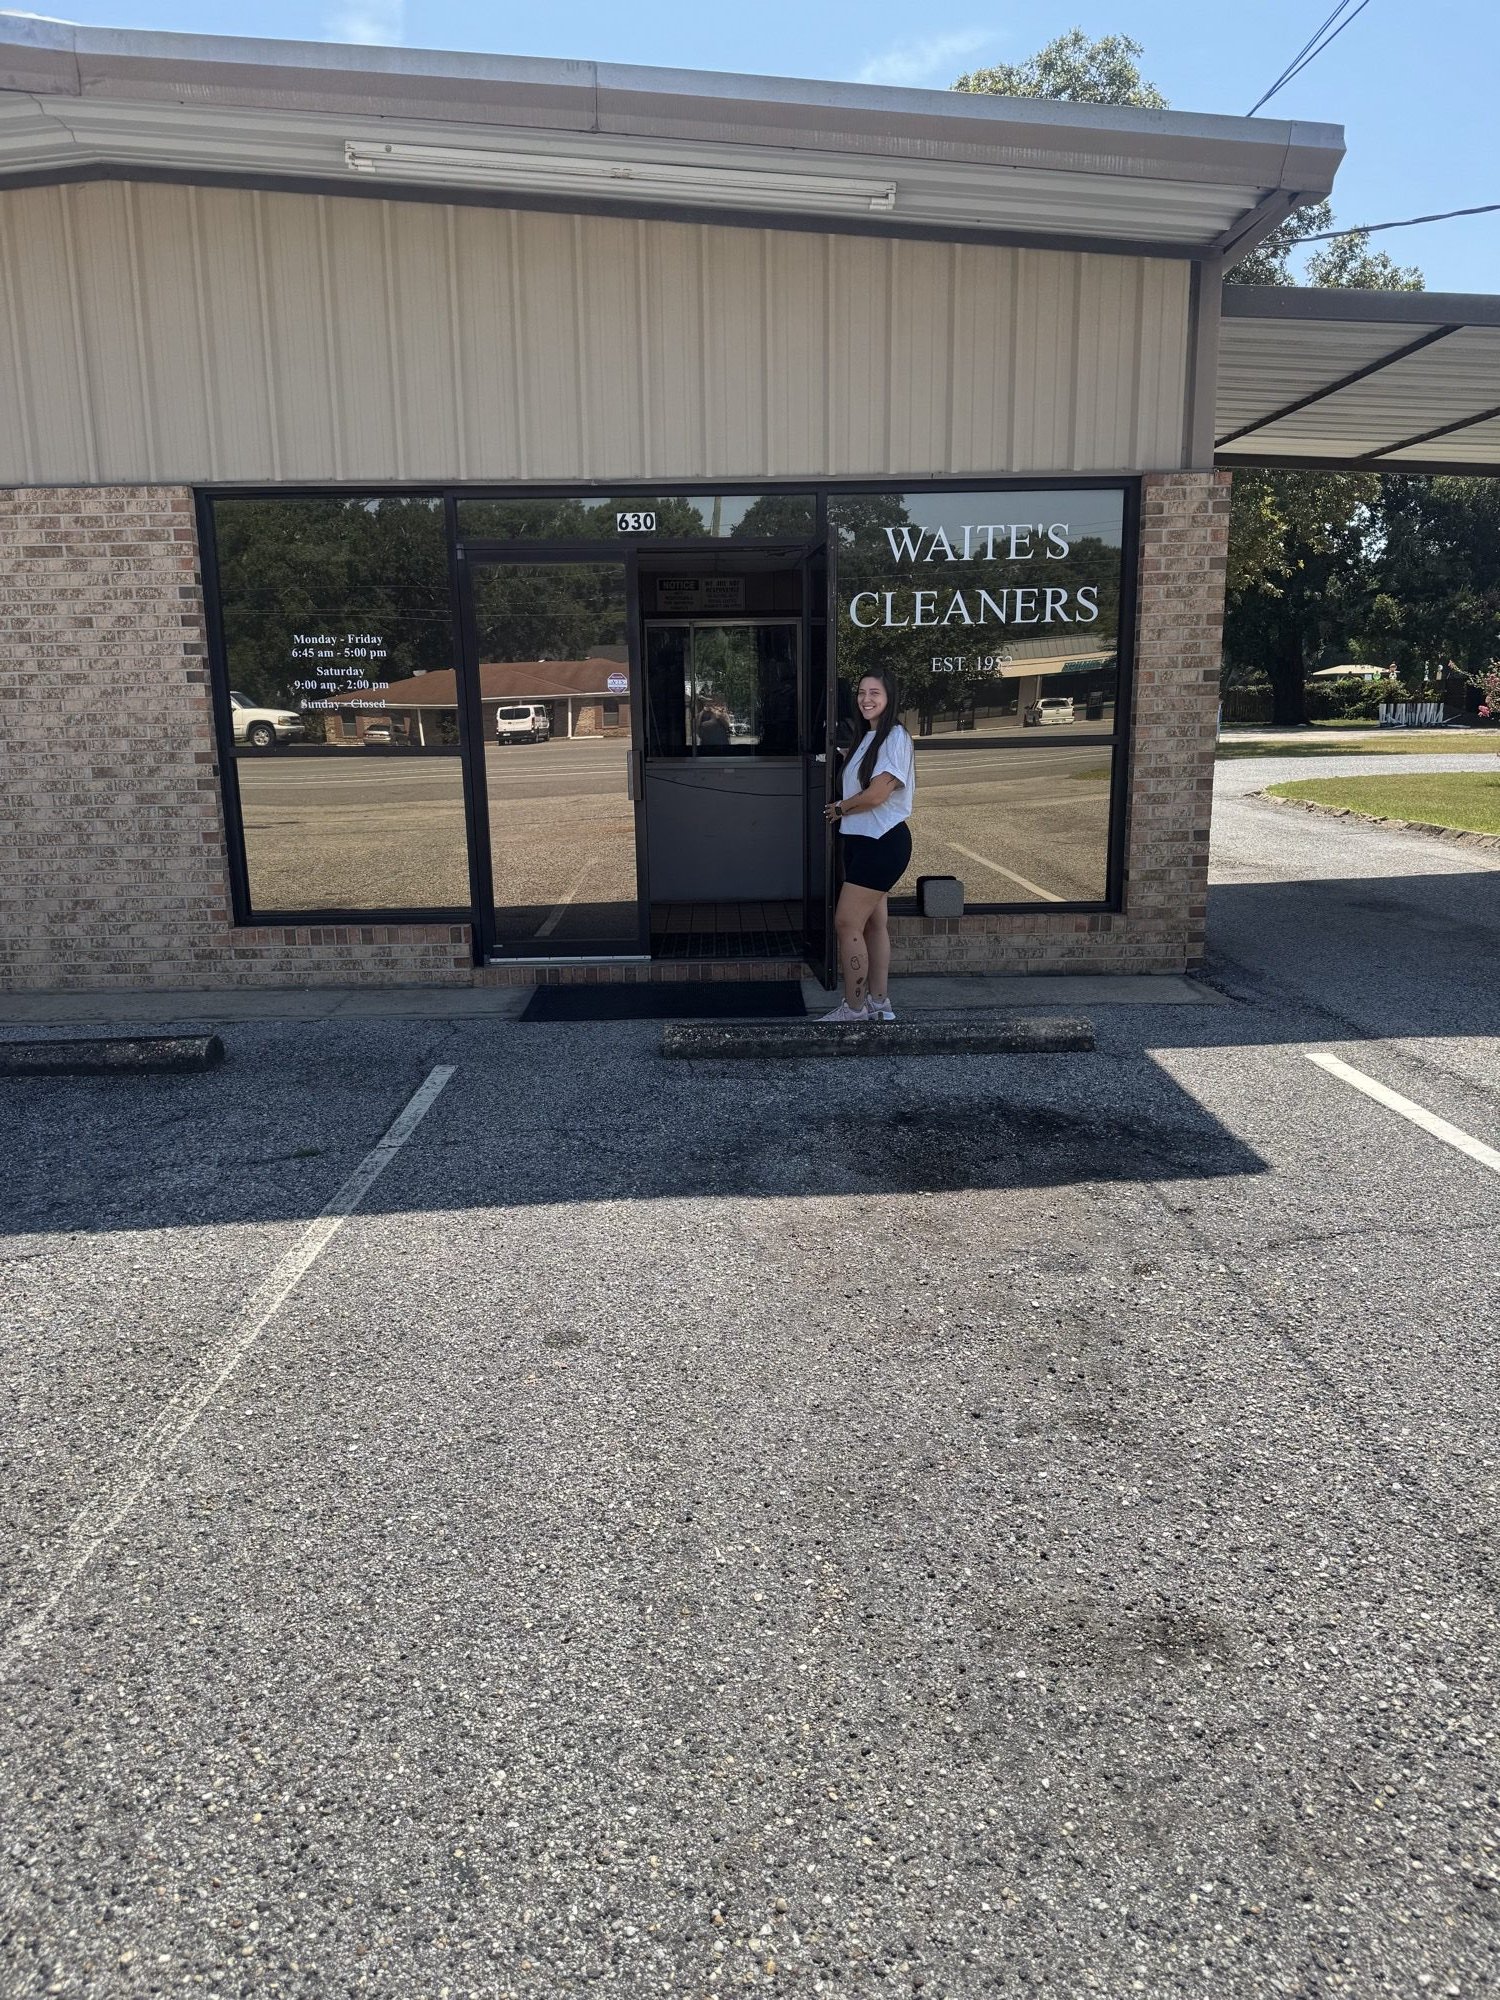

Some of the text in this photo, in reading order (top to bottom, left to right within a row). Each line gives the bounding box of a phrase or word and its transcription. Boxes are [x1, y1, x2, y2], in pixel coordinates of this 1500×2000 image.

[618, 513, 655, 531] 630
[882, 523, 1070, 563] WAITE'S
[663, 581, 696, 590] NOTICE
[850, 586, 1099, 628] CLEANERS
[293, 634, 337, 646] Monday
[347, 634, 383, 646] Friday
[291, 648, 315, 658] 6:45
[317, 650, 334, 658] am
[344, 648, 367, 657] 5:00
[369, 650, 387, 659] pm
[931, 656, 968, 672] EST.
[316, 667, 365, 678] Saturday
[294, 680, 317, 689] 9:00
[320, 682, 337, 690] am
[346, 680, 369, 689] 2:00
[372, 682, 389, 691] pm
[300, 699, 340, 711] Sunday
[350, 699, 386, 709] Closed
